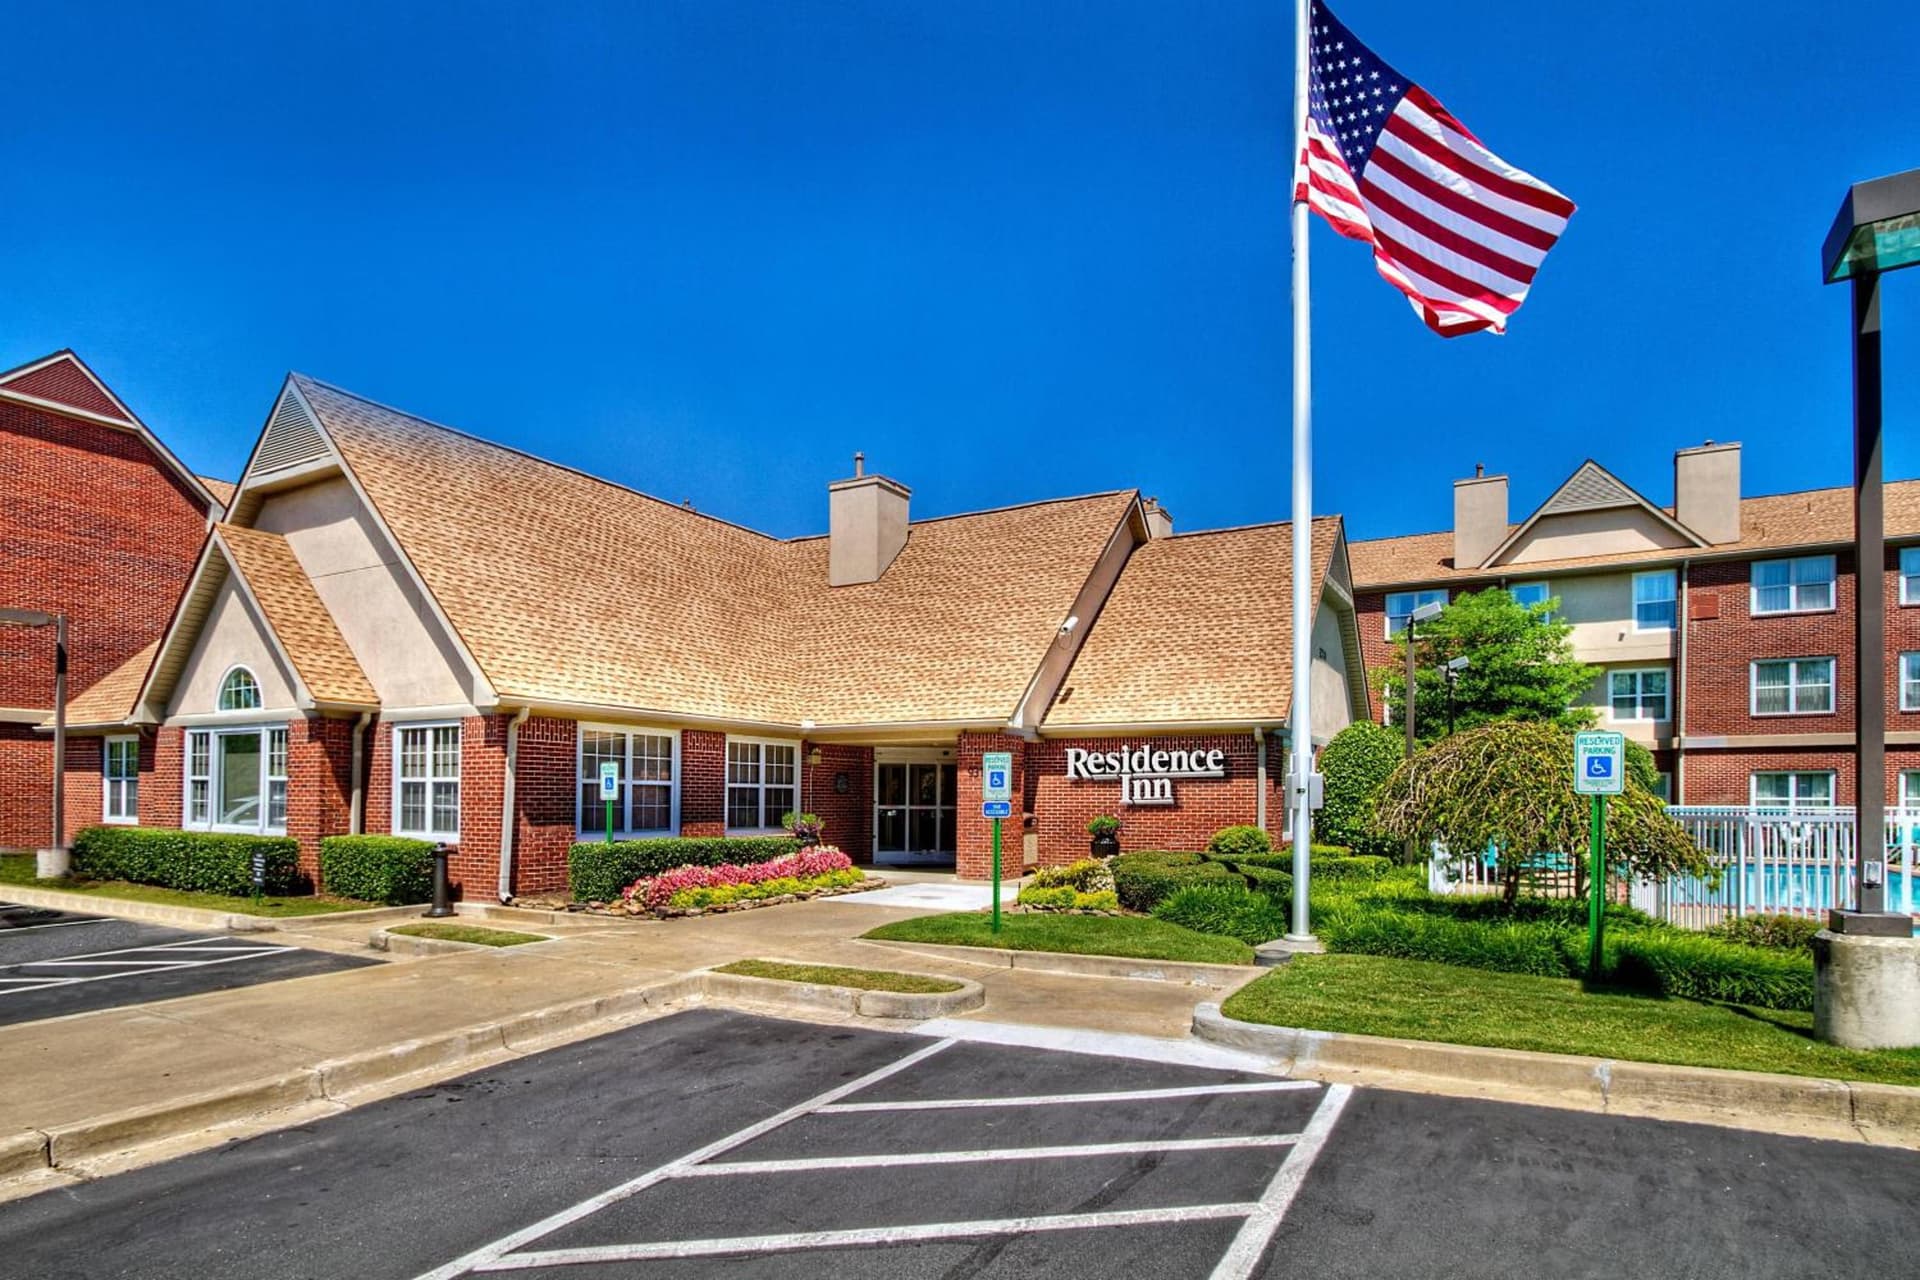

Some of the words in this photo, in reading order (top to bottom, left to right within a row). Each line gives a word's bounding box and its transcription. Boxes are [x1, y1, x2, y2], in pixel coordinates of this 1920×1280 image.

[1579, 736, 1620, 745] RESERVED
[1583, 746, 1616, 755] PARKING
[1065, 744, 1224, 780] Residence
[1119, 774, 1174, 804] Inn
